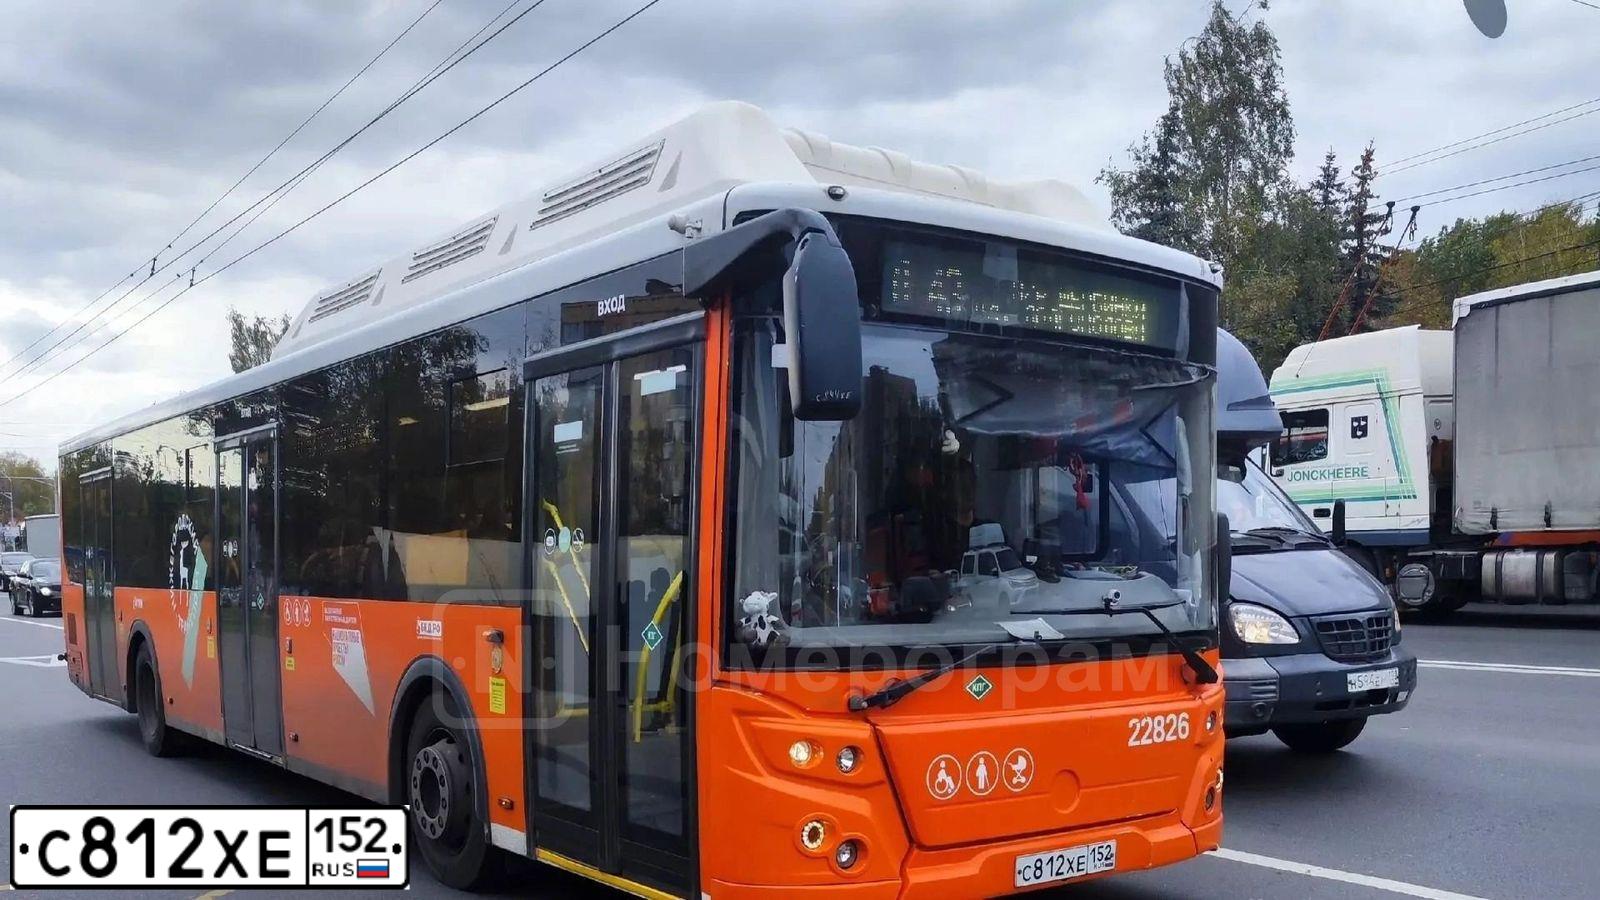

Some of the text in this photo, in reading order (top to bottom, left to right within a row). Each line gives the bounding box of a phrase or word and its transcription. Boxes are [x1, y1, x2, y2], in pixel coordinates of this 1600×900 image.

[598, 294, 626, 317] ВХОД
[1287, 466, 1369, 482] JONCKHEERE
[972, 682, 987, 692] КПГ
[1128, 712, 1190, 747] 22826
[1022, 844, 1112, 882] С812ХЕ 152
